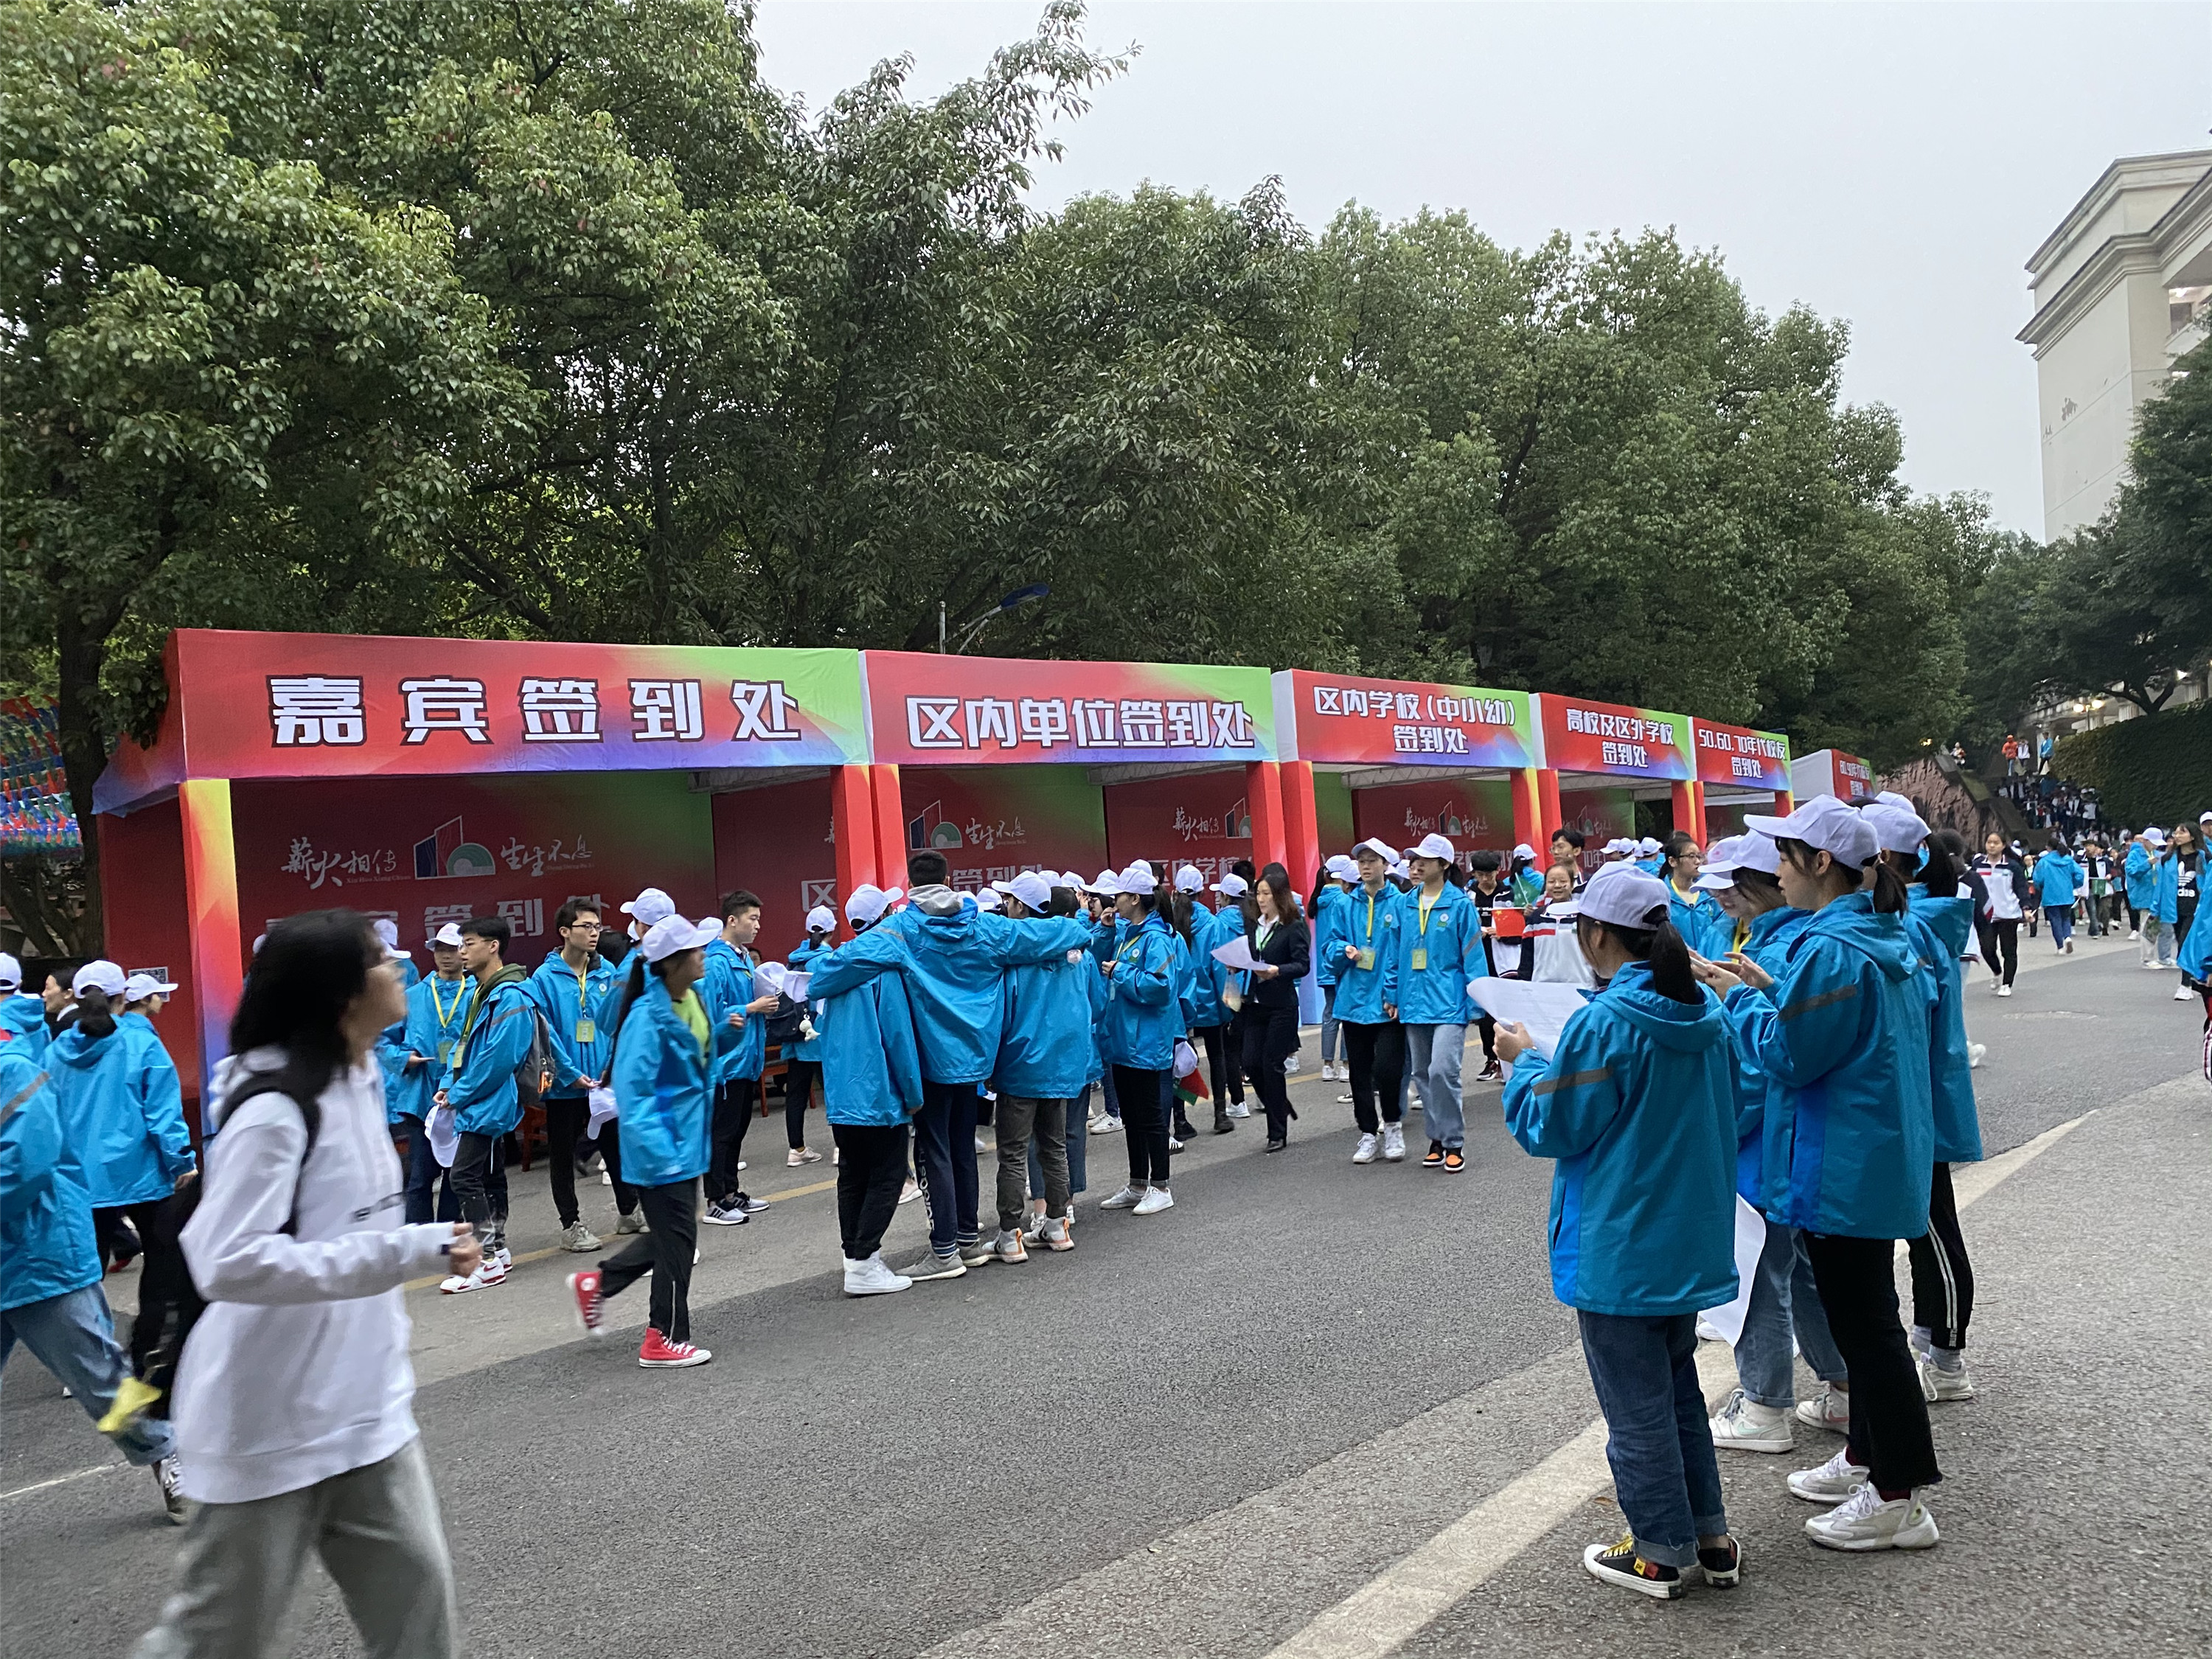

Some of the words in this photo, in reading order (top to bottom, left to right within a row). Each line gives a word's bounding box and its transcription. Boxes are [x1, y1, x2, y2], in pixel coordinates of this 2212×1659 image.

[268, 674, 801, 746] 嘉宾签到处
[905, 695, 1254, 749] 区内单位签到处
[1566, 708, 1674, 745] 高校及区外学校
[1393, 725, 1469, 754] 签到处
[1602, 741, 1648, 768] 签到处
[1731, 757, 1763, 779] 签到处
